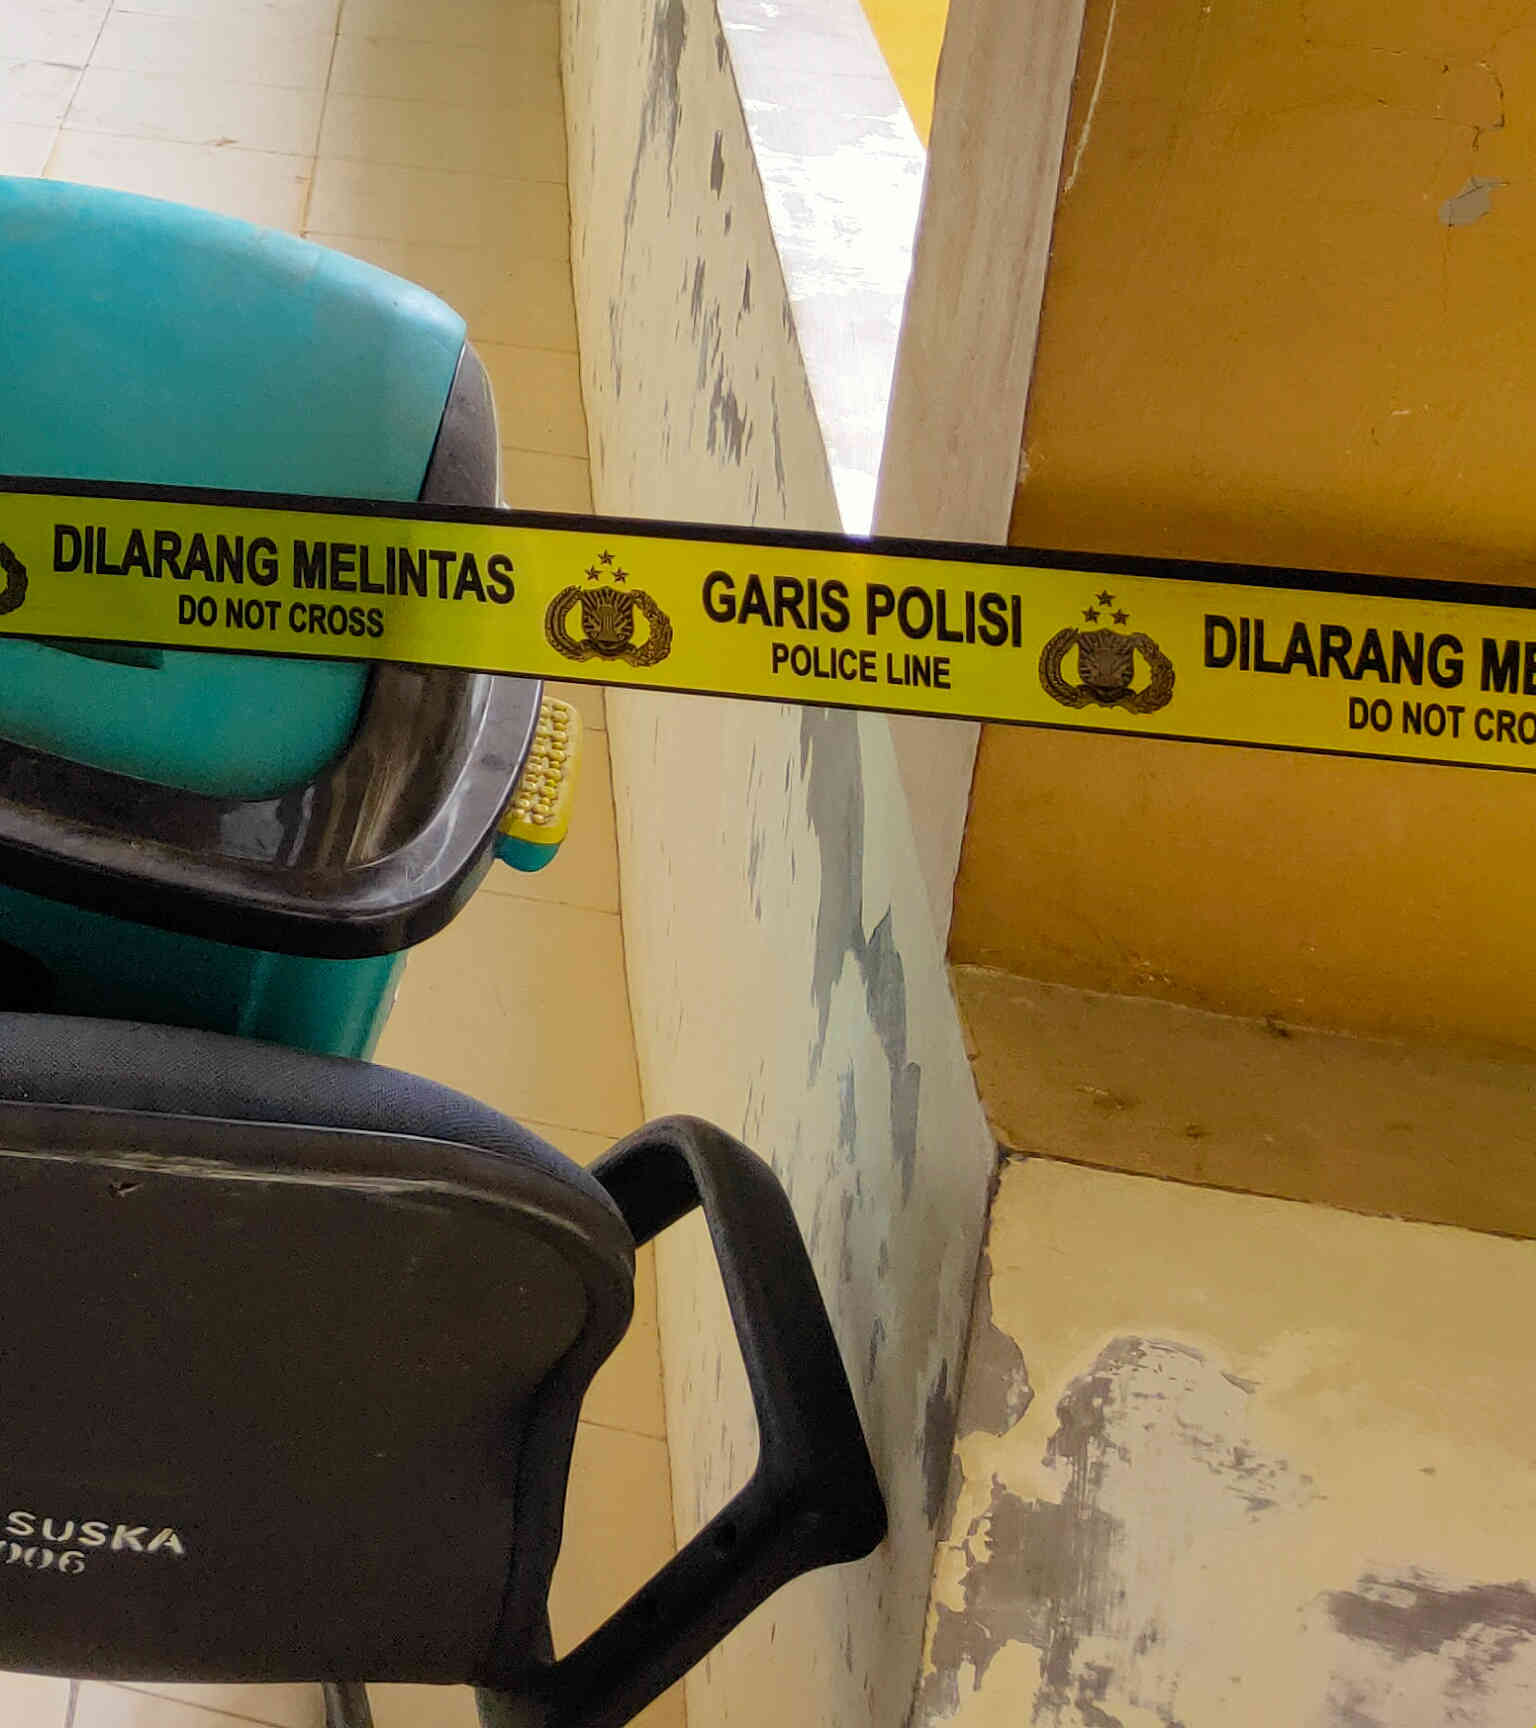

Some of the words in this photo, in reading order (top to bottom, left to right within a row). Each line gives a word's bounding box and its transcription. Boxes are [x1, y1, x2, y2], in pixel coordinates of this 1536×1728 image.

[52, 524, 278, 587] DILARANG
[292, 539, 515, 605] MELINTAS
[178, 594, 218, 627] DO
[225, 598, 282, 631] NOT
[288, 602, 385, 638] CROSS
[701, 570, 851, 633] GARIS
[866, 582, 1023, 648] POLISI
[771, 642, 877, 683] POLICE
[887, 653, 952, 689] LINE
[1203, 613, 1464, 689] DILARANG
[1348, 696, 1393, 732] DO
[1402, 700, 1465, 739] NOT
[1474, 708, 1536, 745] CRO
[6, 1510, 186, 1556] SUSKA
